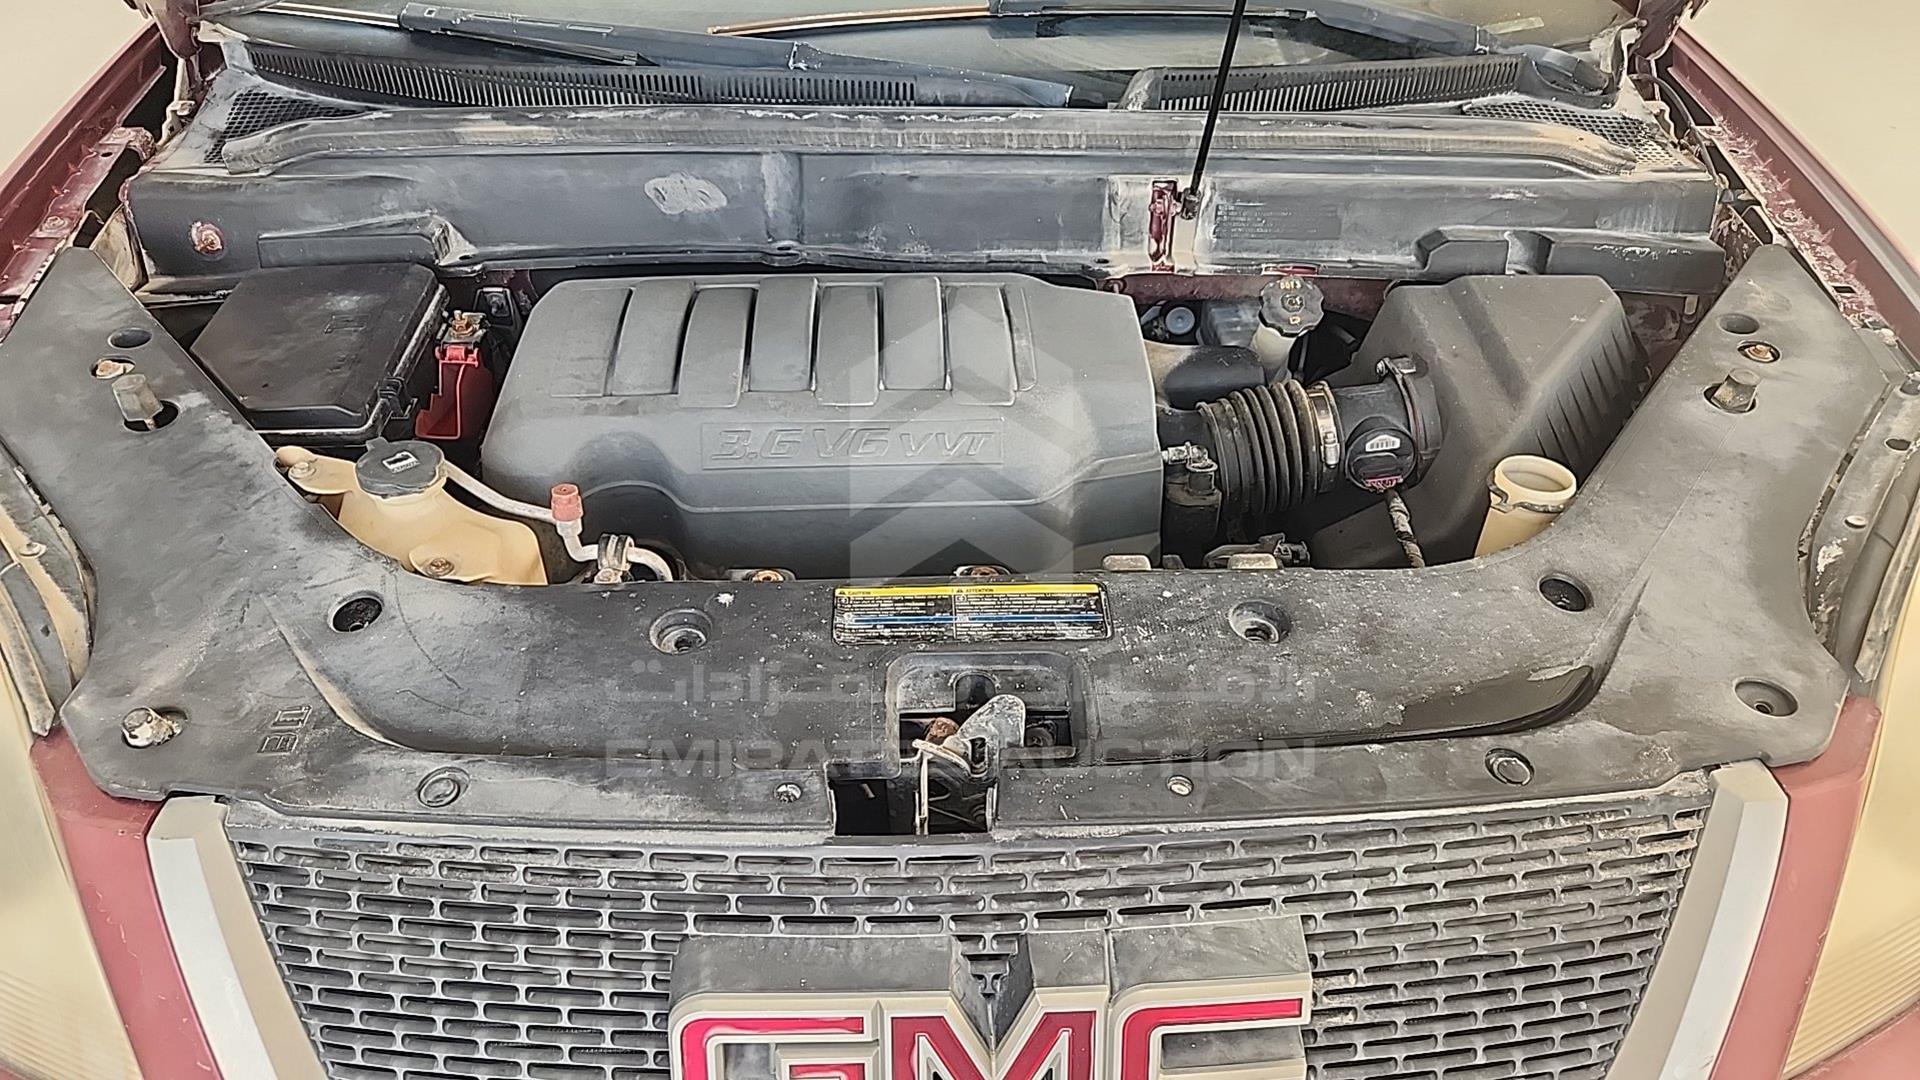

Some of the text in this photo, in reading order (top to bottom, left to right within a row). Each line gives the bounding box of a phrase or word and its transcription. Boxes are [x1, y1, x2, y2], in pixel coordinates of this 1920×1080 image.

[711, 427, 994, 460] 3.6 V6 VVT
